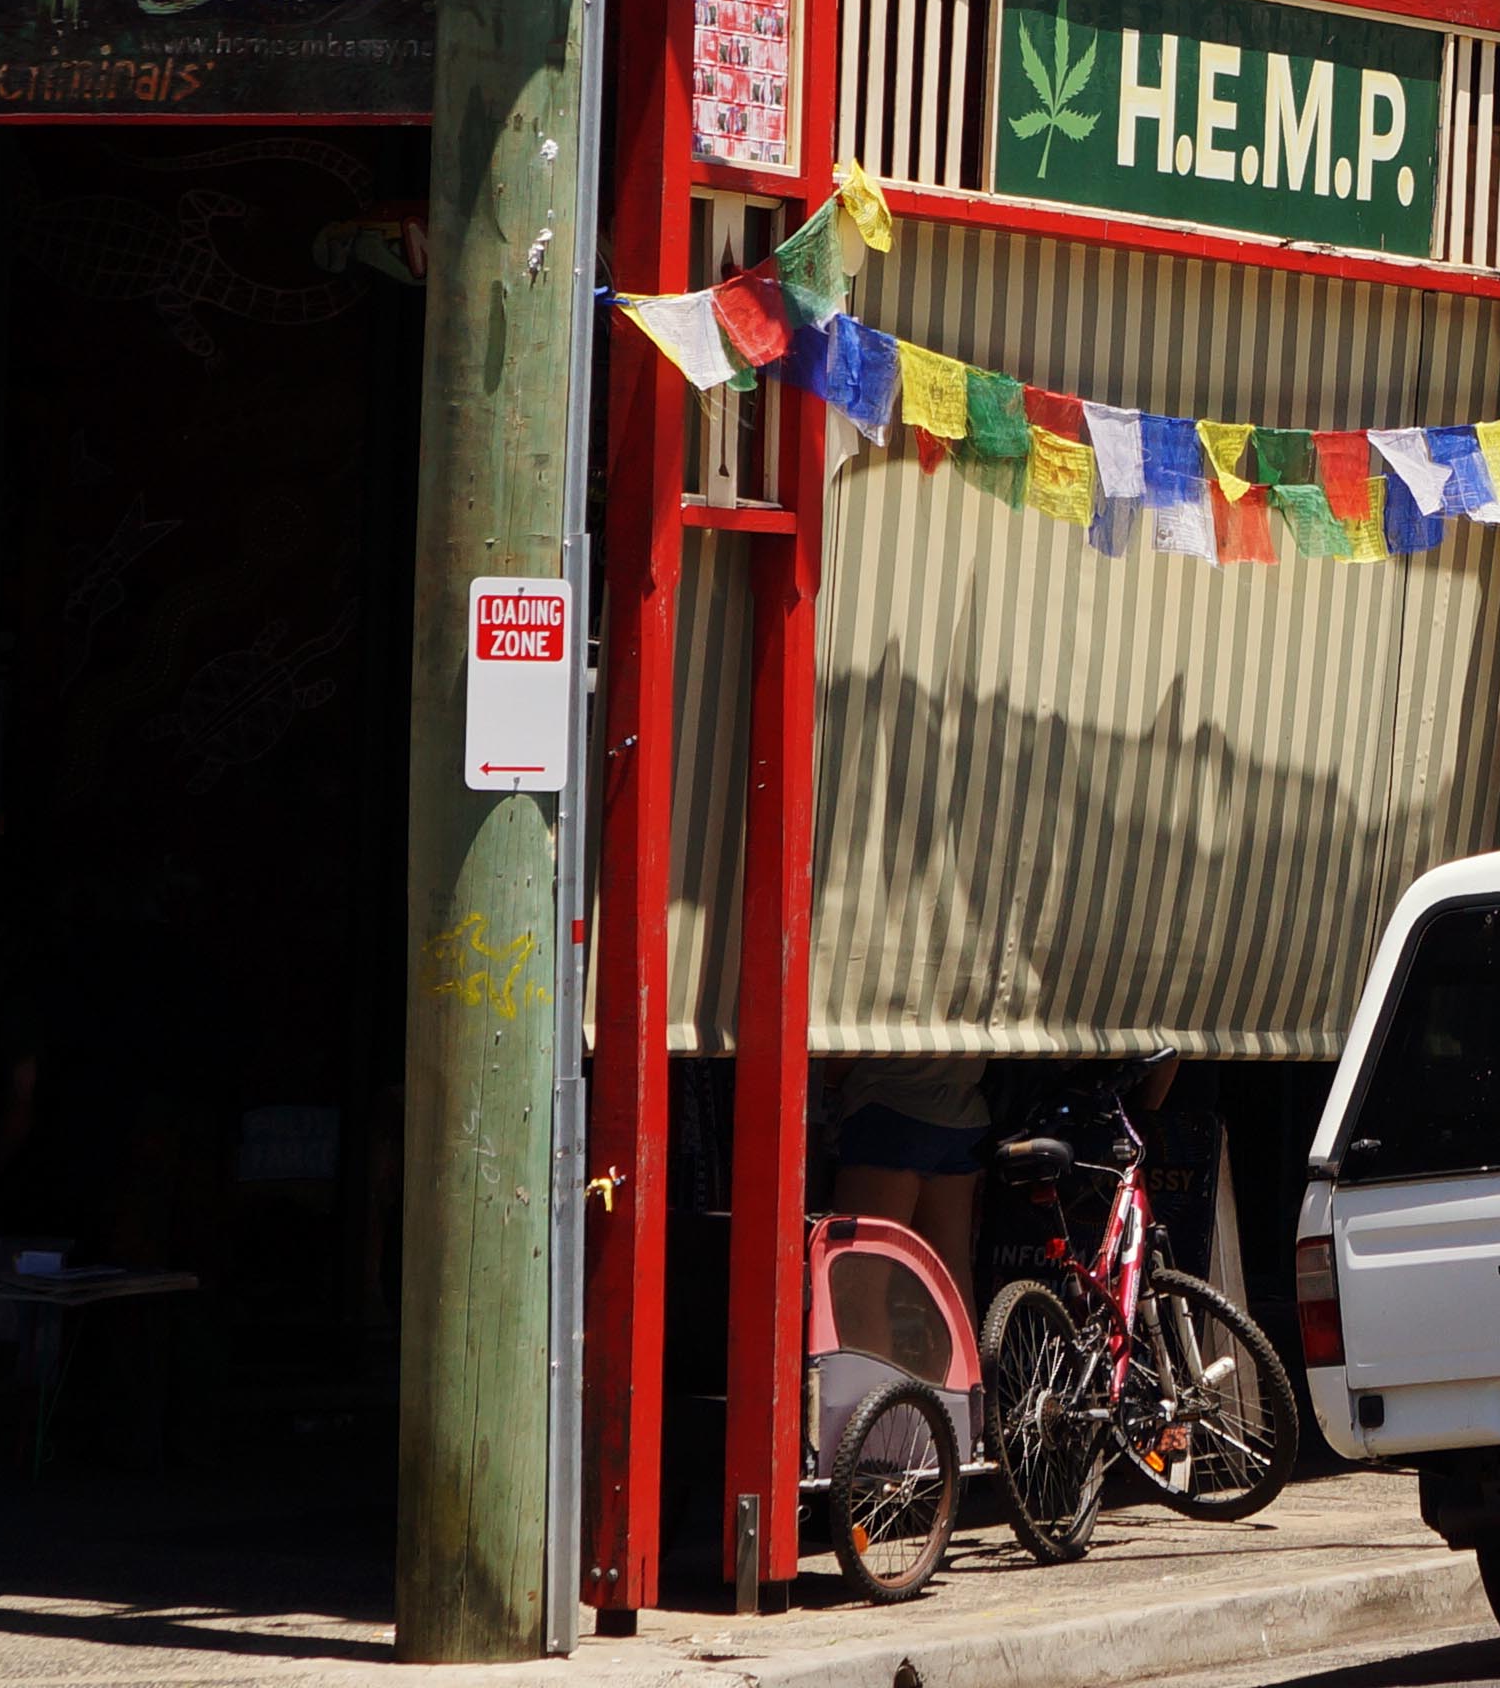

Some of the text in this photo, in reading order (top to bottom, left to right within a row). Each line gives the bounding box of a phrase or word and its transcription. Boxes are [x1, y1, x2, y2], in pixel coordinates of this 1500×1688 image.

[1117, 27, 1415, 208] H.E.M.P.
[480, 598, 561, 627] LOADING
[491, 630, 551, 657] ZONE
